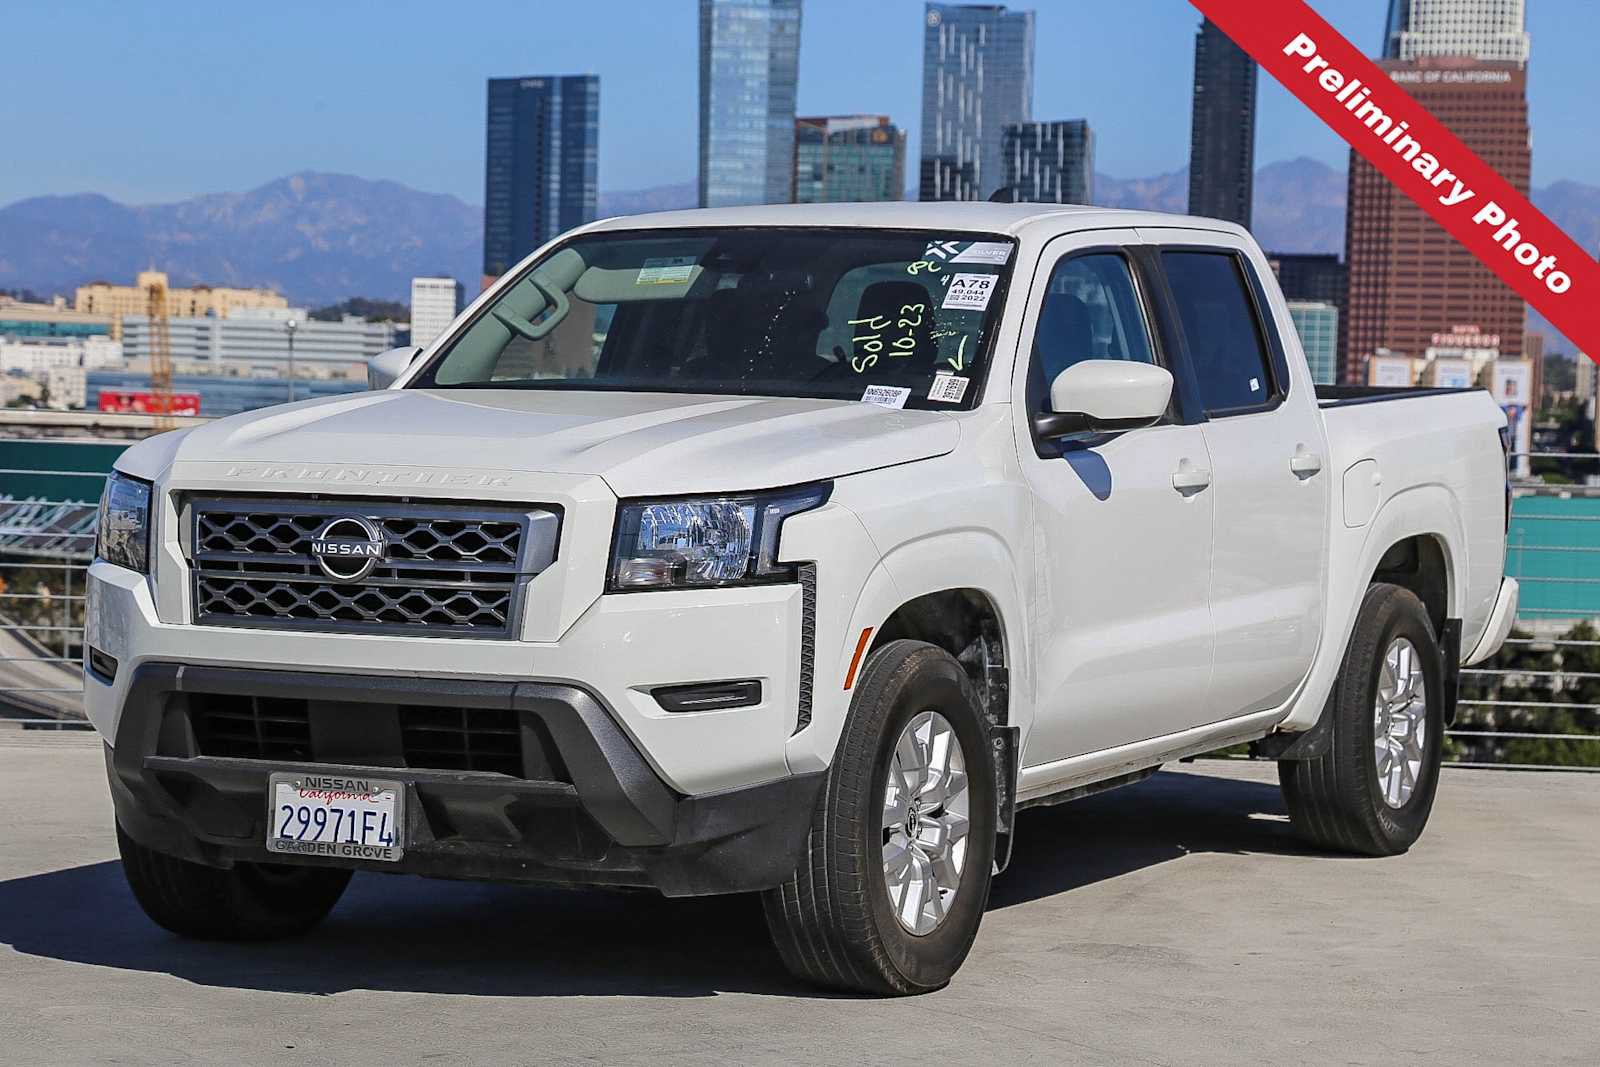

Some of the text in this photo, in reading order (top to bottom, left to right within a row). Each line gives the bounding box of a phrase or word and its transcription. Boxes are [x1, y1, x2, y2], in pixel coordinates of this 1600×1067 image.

[1424, 71, 1441, 83] OF
[1442, 71, 1511, 83] CALIFORNIA
[952, 279, 990, 289] A78
[888, 303, 926, 357] 10-23
[225, 466, 513, 487] FRONTIER
[311, 542, 381, 555] NISSAN
[305, 777, 369, 791] NISSAN
[280, 805, 393, 846] 29971F4
[275, 840, 394, 860] GARDEN GROVE
